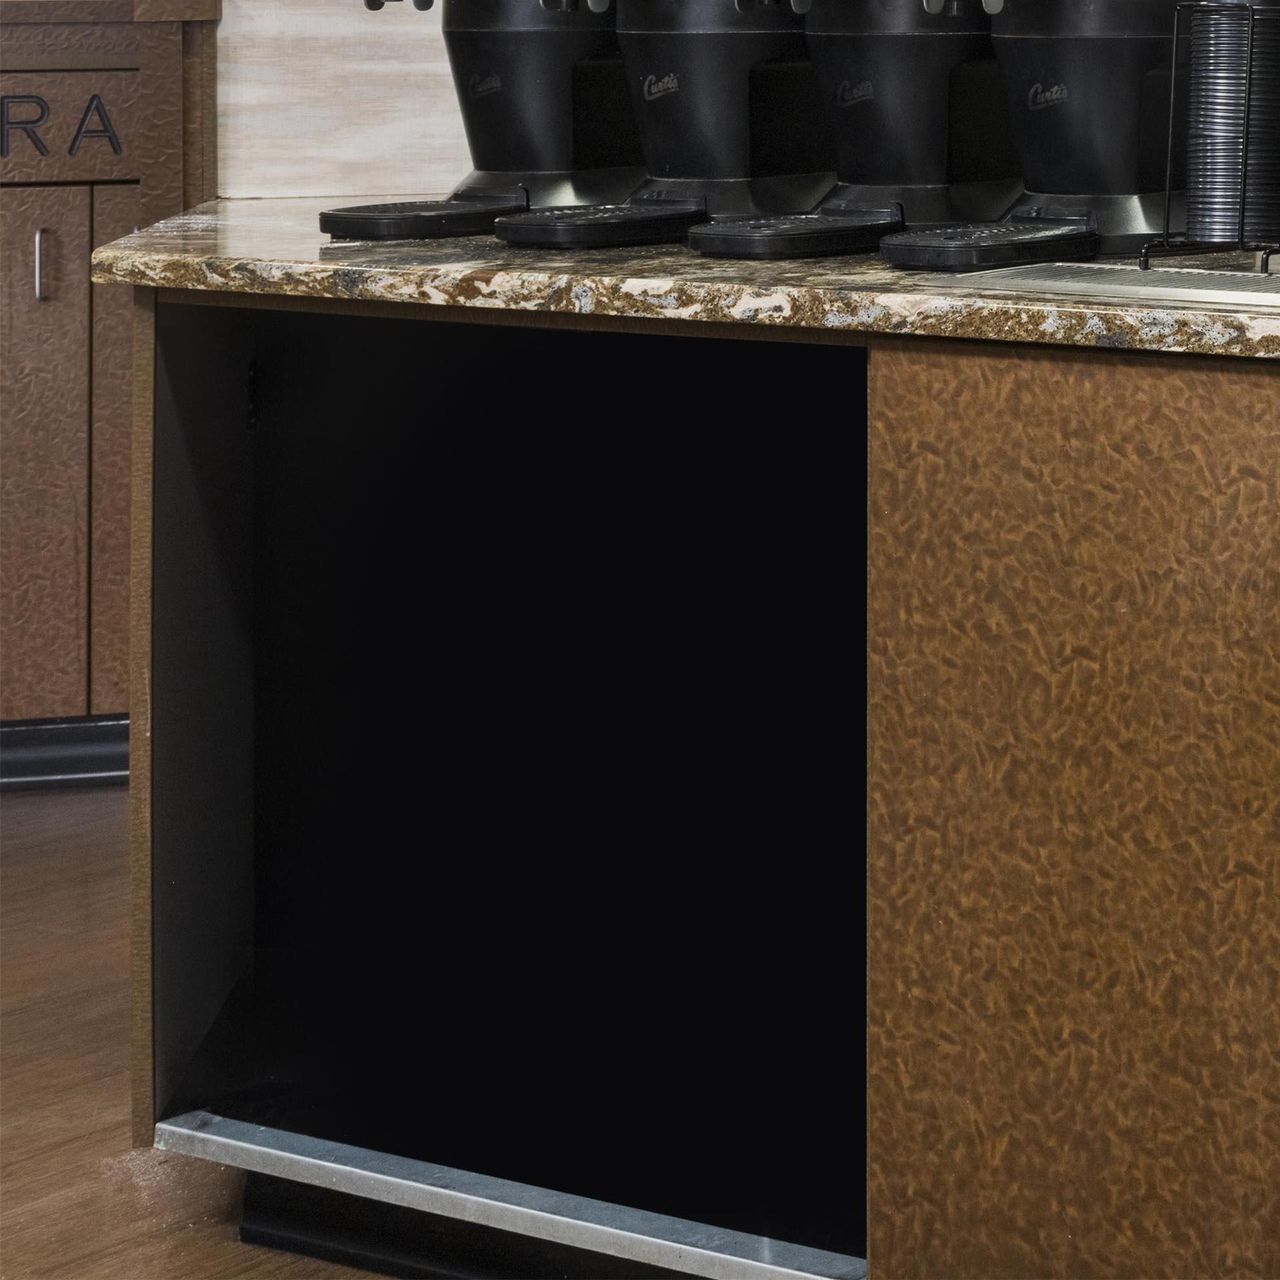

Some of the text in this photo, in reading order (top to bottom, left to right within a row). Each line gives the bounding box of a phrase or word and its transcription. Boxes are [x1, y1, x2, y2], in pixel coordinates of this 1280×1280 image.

[643, 73, 680, 101] Curtis
[1028, 83, 1069, 111] Curtis
[0, 94, 123, 157] RA
